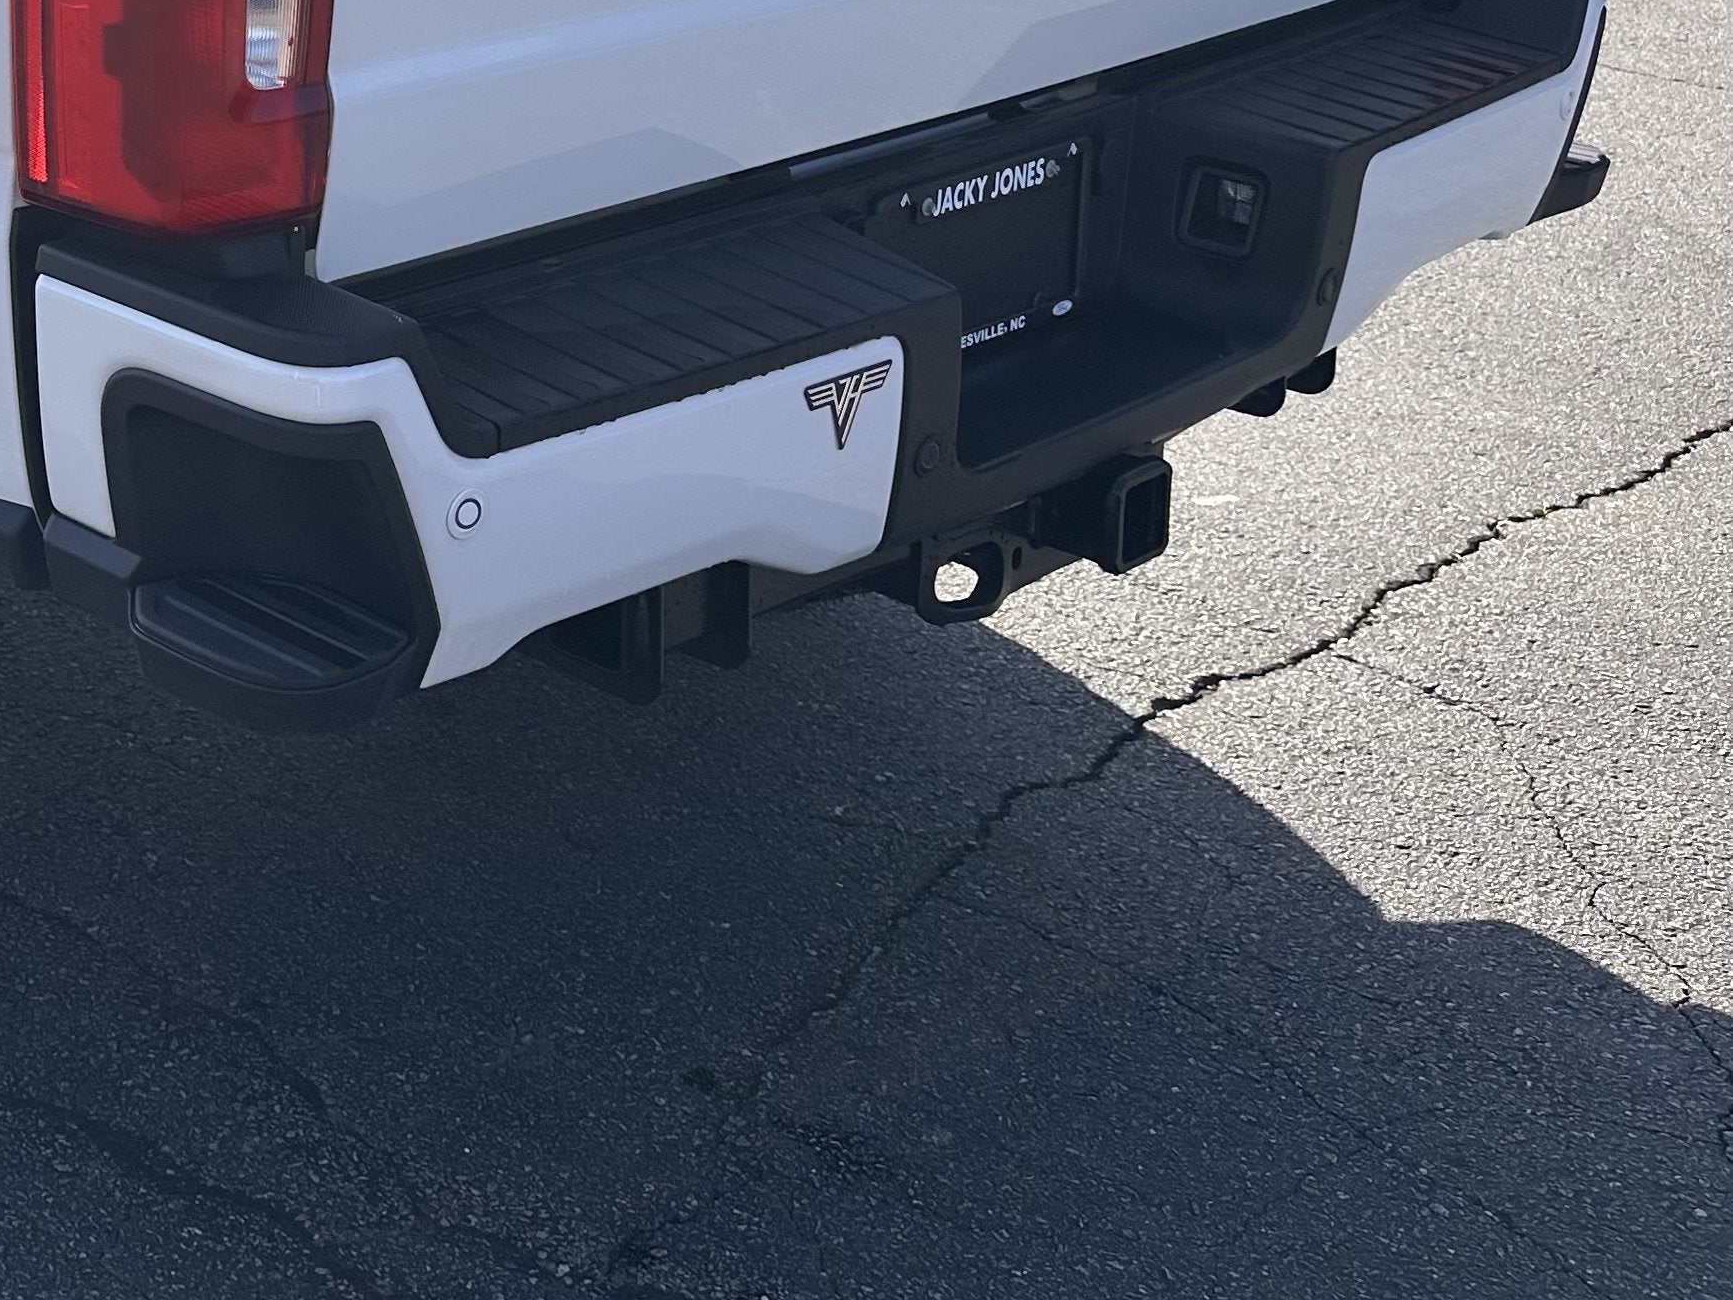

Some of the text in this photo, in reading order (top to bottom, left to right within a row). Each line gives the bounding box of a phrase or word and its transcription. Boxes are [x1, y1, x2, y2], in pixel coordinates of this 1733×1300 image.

[933, 157, 1045, 217] JACKY JONES
[960, 315, 1026, 349] ESVILLE, NC
